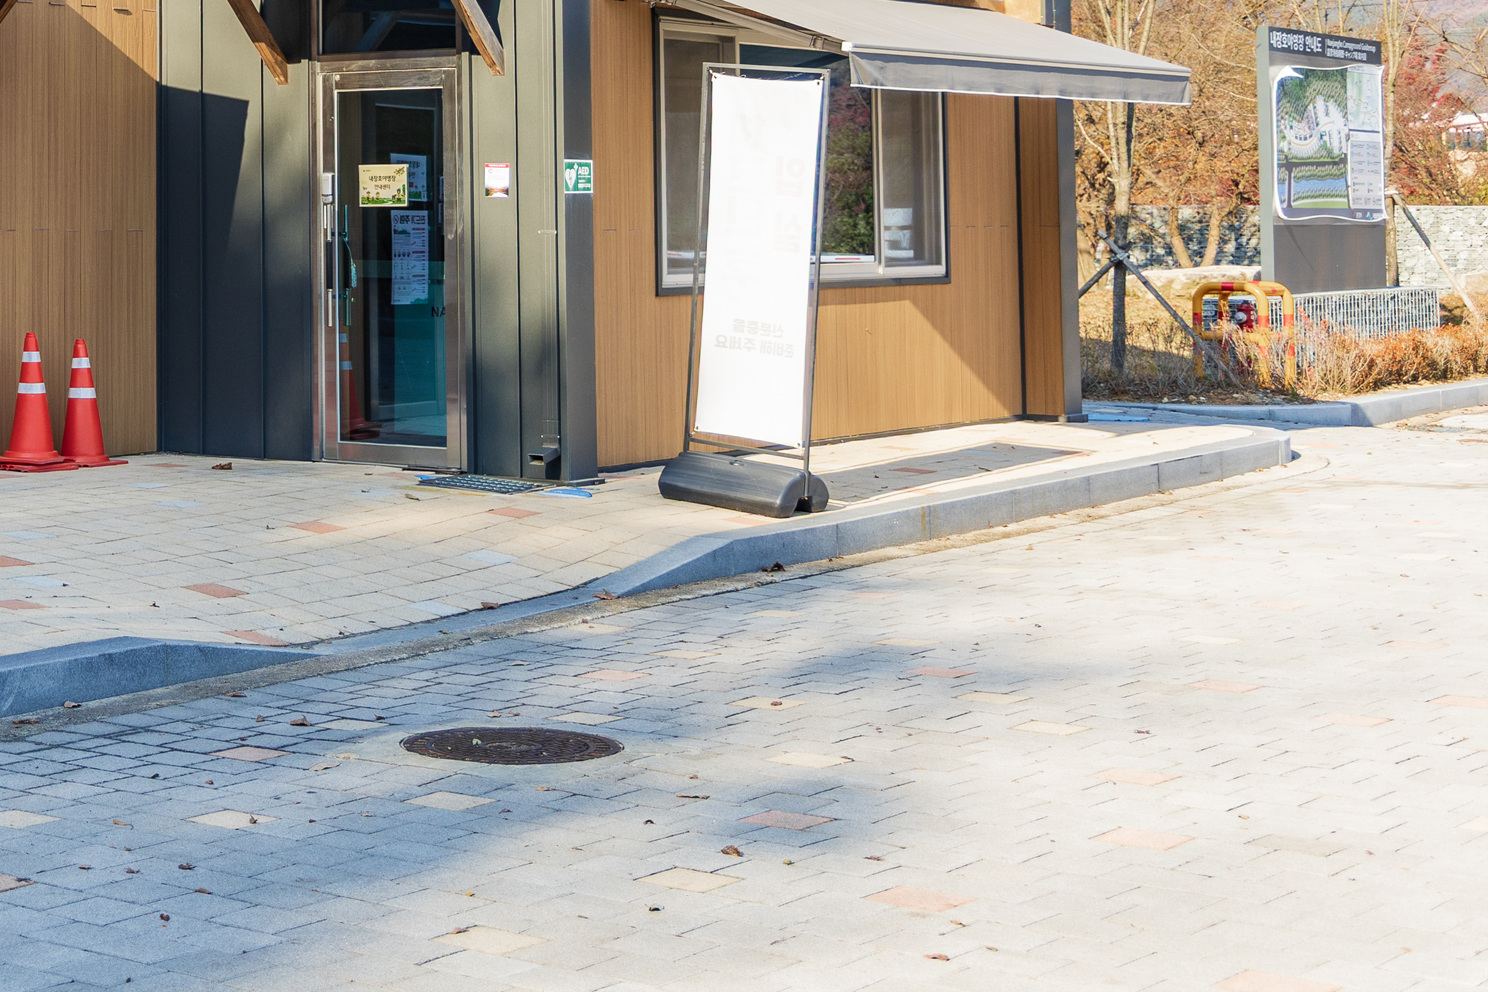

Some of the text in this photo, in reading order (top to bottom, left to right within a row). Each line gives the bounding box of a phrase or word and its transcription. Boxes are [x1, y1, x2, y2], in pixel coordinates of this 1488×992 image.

[1270, 31, 1322, 53] 내장호야영장 안내도
[577, 166, 590, 175] AED
